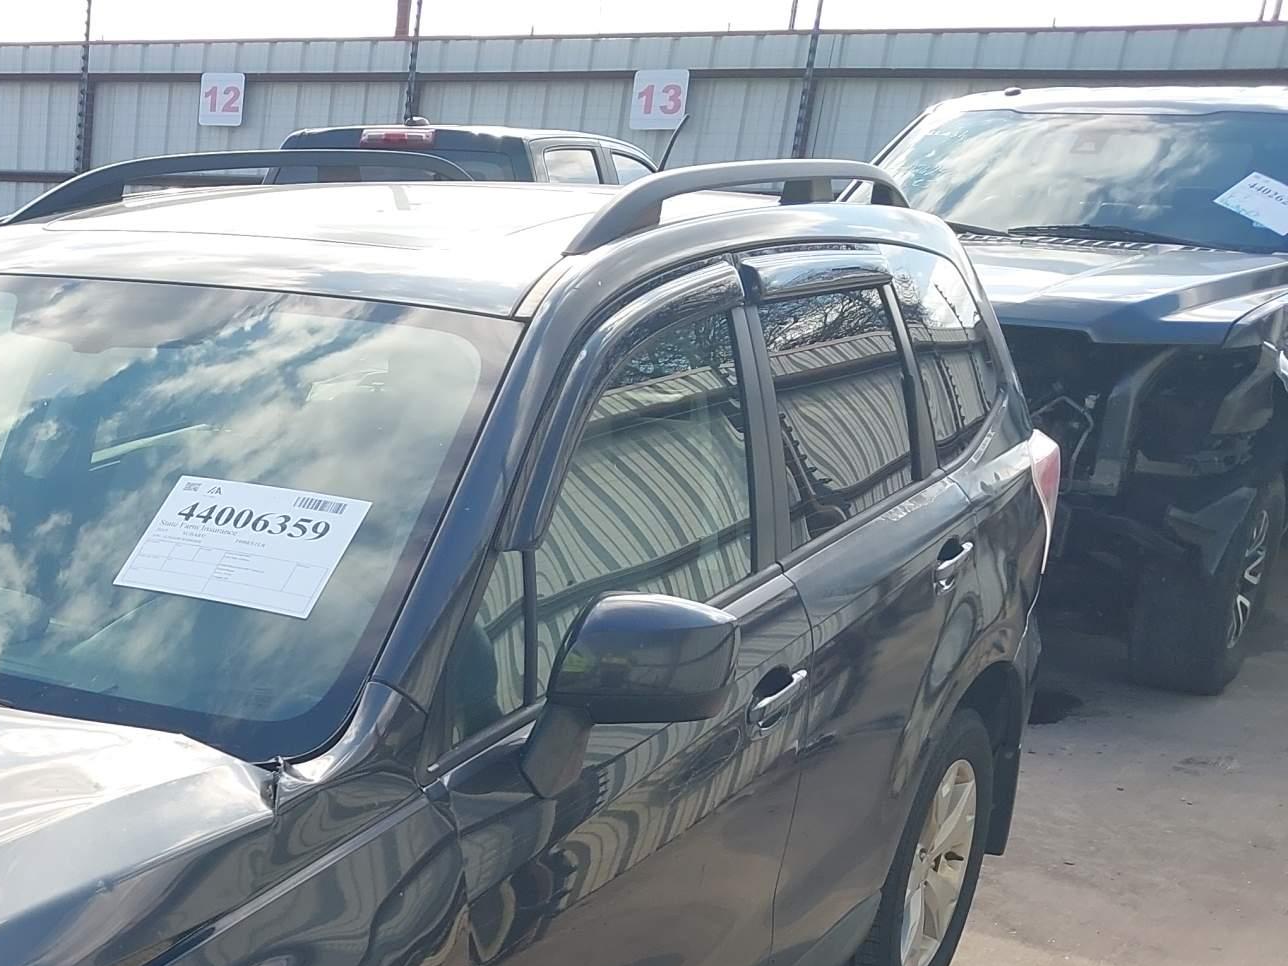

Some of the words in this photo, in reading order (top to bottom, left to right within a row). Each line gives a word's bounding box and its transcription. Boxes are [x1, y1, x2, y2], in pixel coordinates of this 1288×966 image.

[204, 86, 240, 112] 12
[637, 84, 682, 114] 13
[159, 519, 179, 528] State
[180, 522, 199, 531] Farm
[200, 524, 239, 536] Insurance
[177, 502, 331, 541] 44006359
